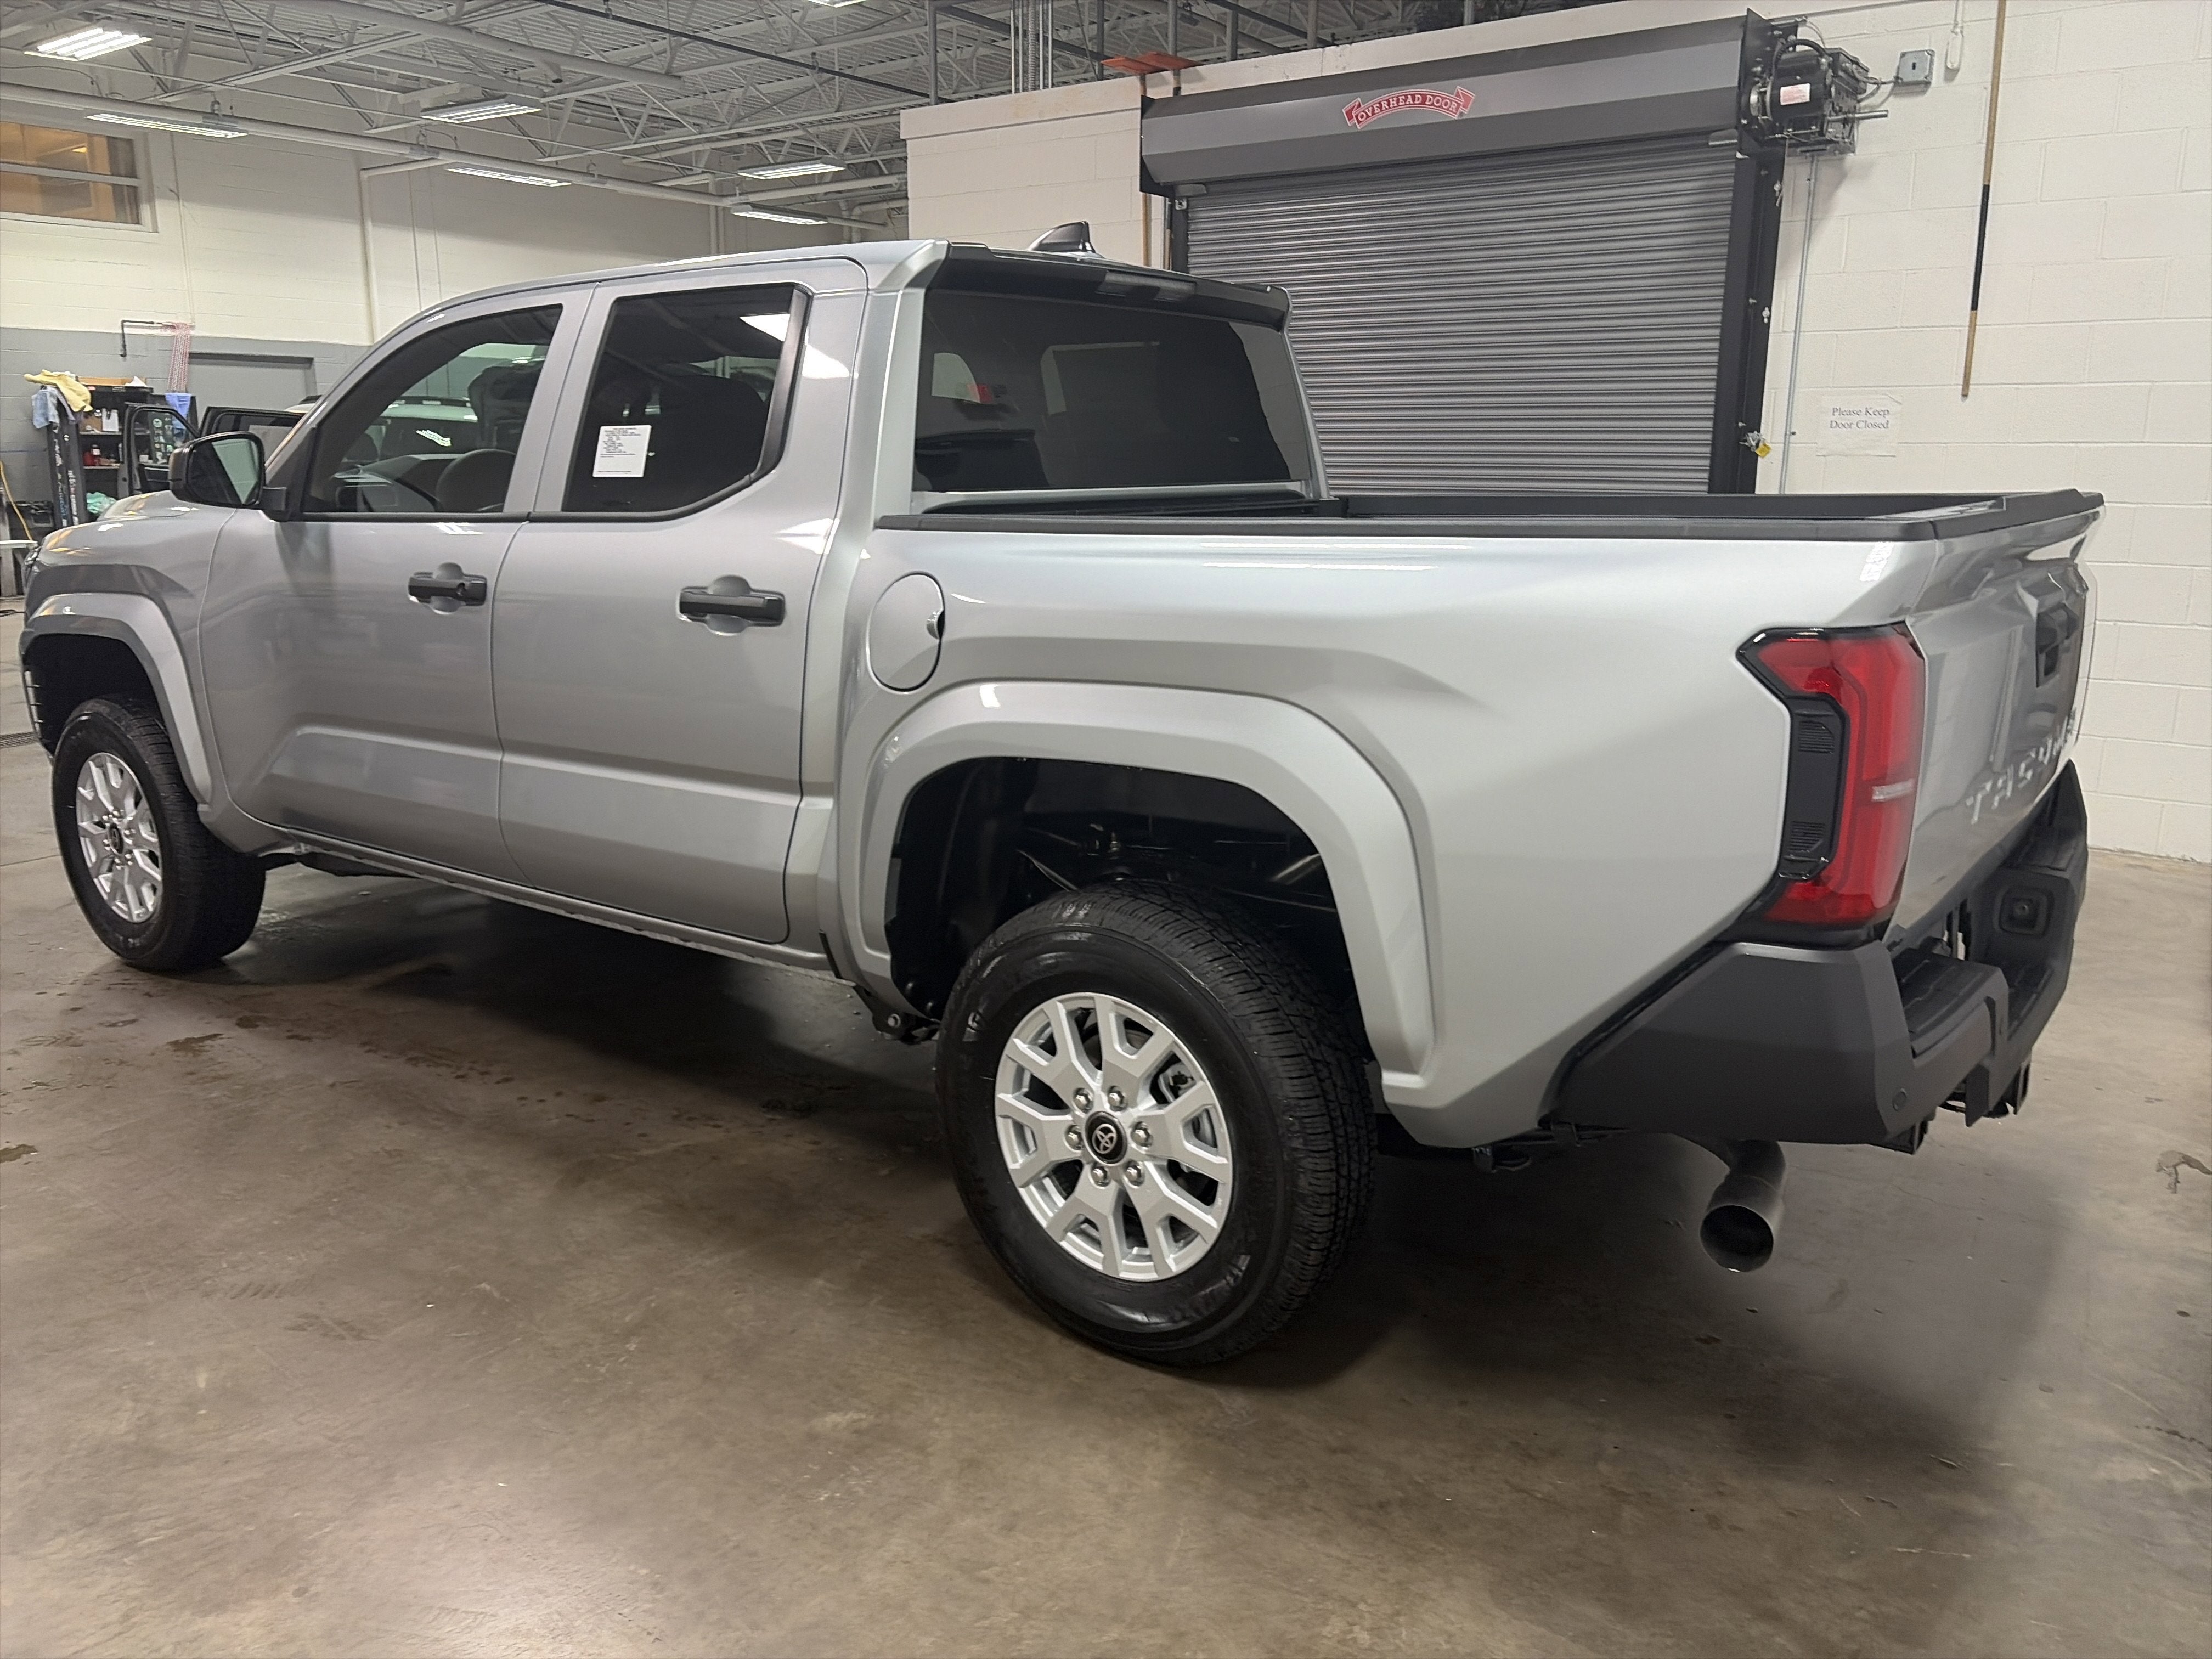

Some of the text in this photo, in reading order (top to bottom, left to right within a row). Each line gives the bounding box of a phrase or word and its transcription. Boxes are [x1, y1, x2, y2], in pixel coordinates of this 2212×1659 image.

[1358, 94, 1457, 121] OVERHEAD DOOR
[1832, 407, 1890, 418] Please Keep
[1830, 420, 1889, 429] Door Closed
